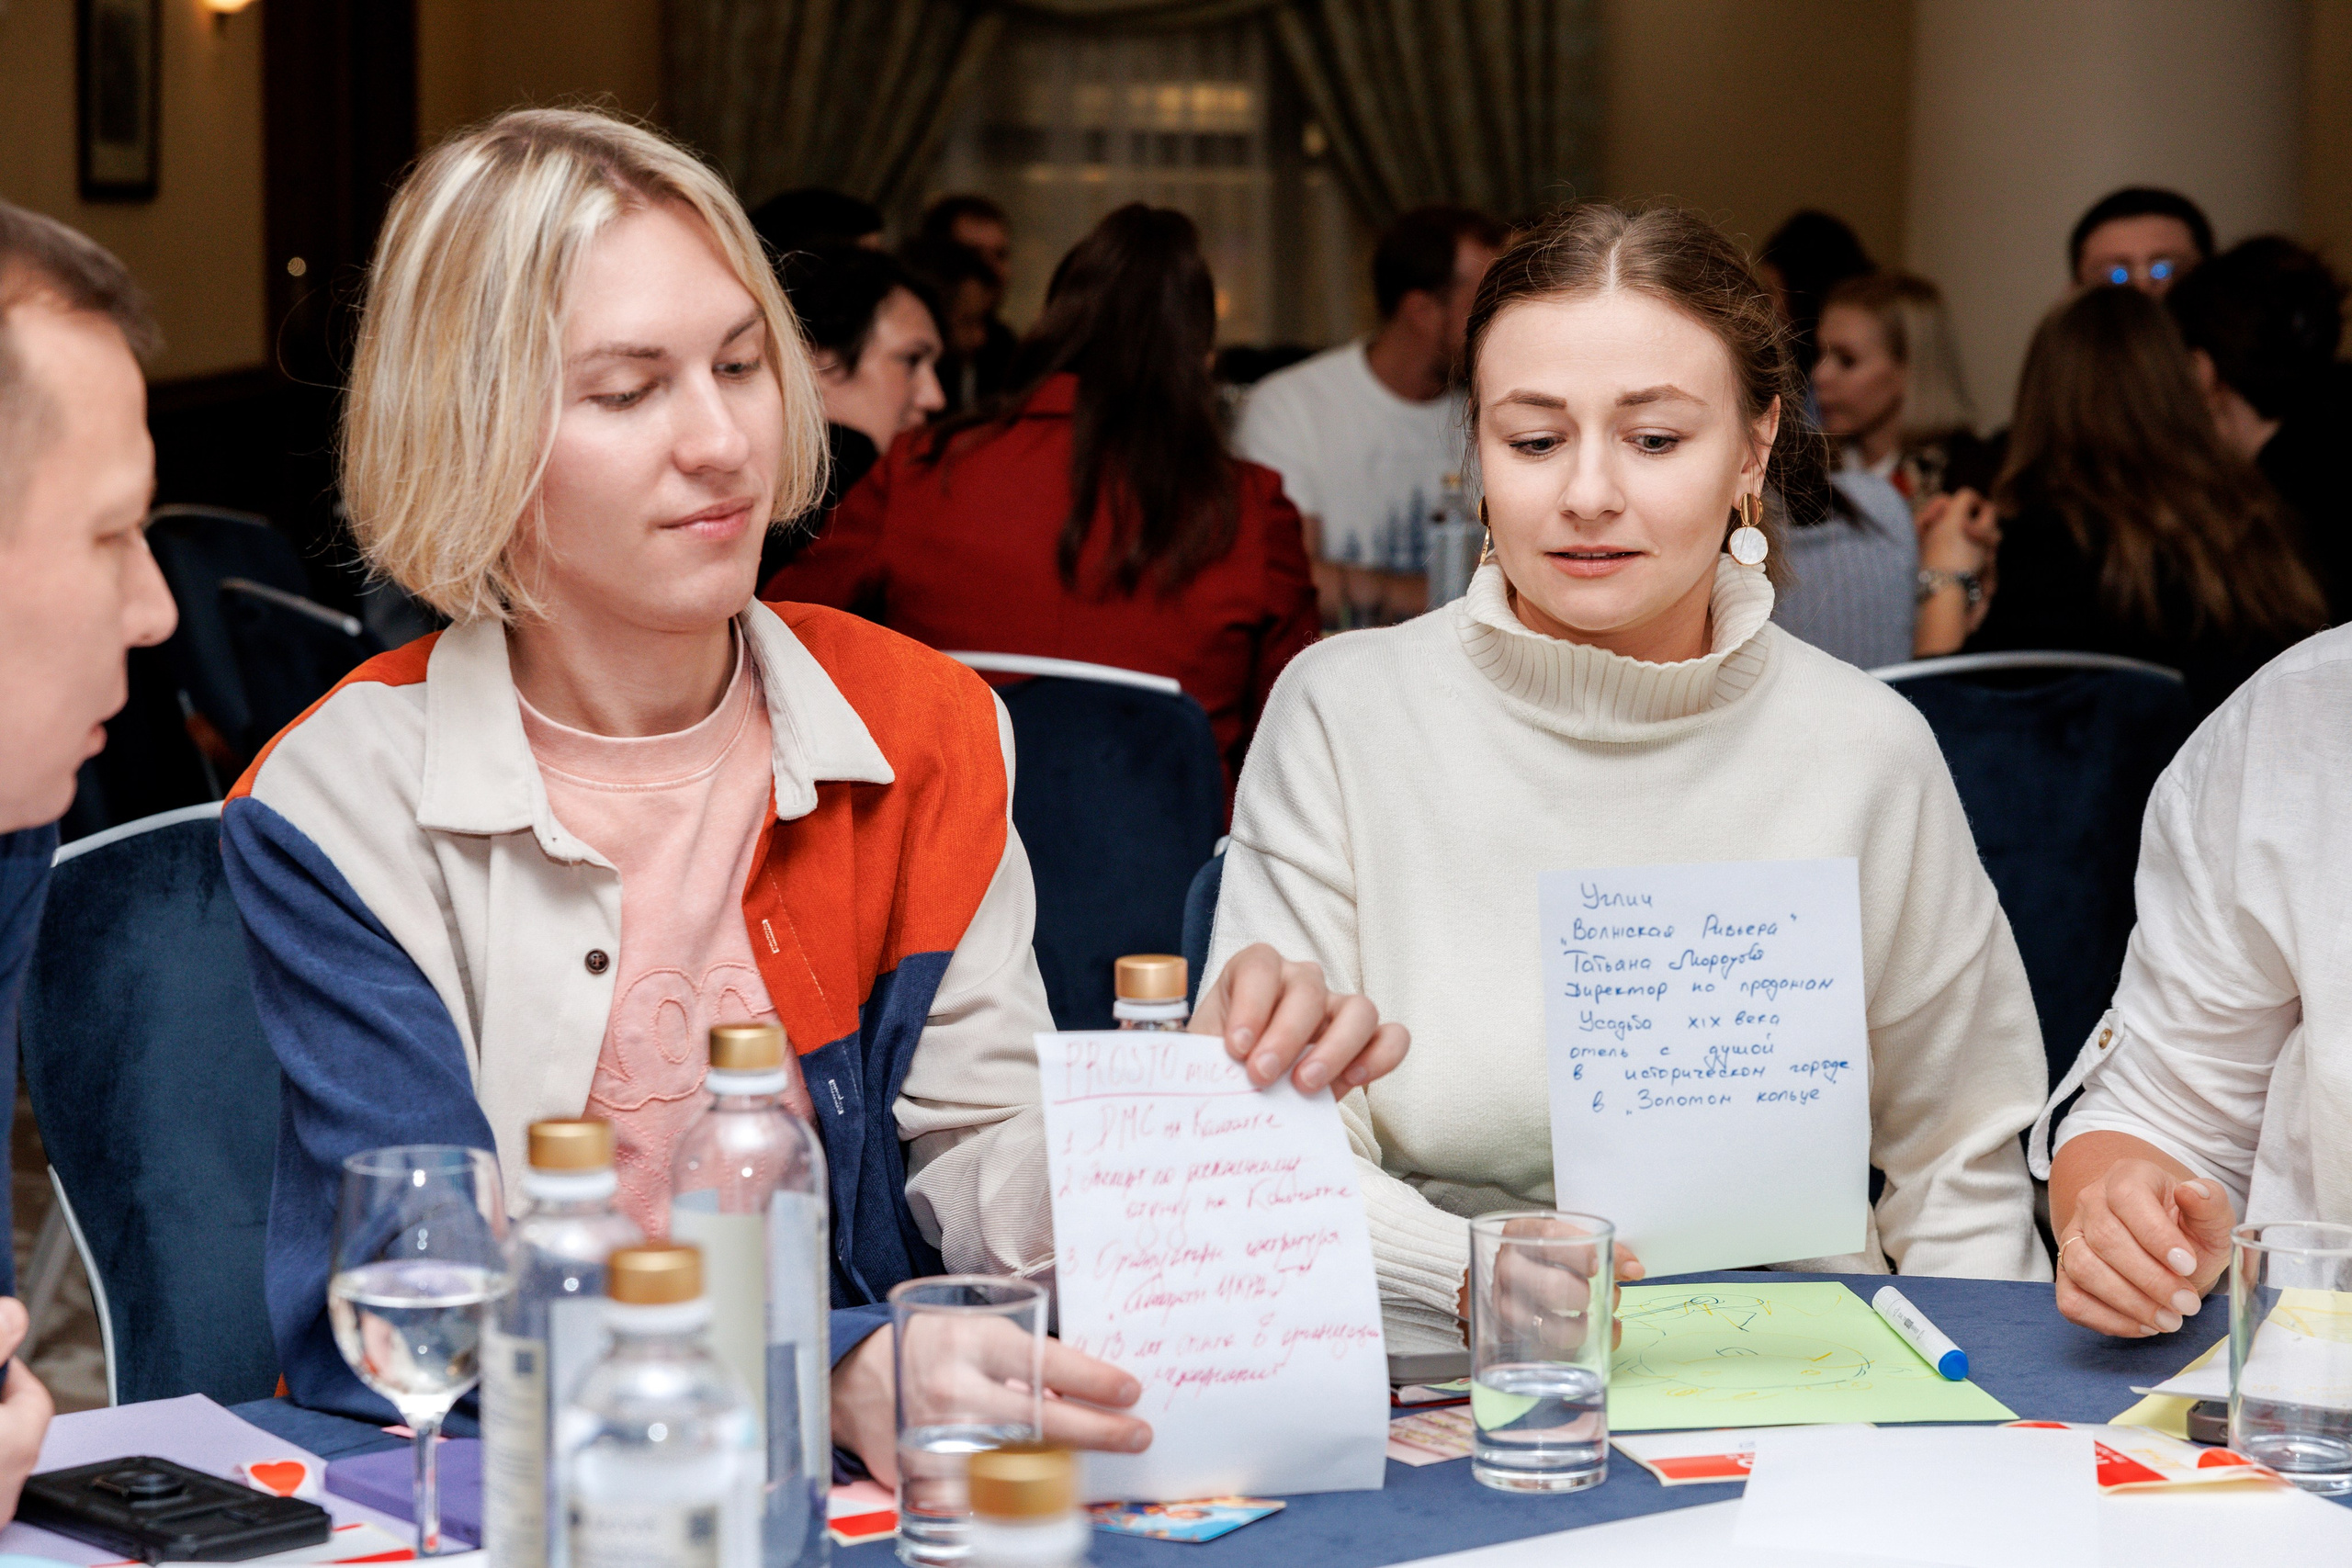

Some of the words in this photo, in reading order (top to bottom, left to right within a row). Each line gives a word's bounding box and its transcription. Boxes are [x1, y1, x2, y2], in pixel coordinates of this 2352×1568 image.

[1580, 882, 1654, 909] Углич
[1564, 981, 1668, 1004] Директор
[1692, 981, 1715, 993] по
[1578, 1010, 1652, 1041] Усадьба
[1735, 1010, 1781, 1026] века
[1569, 1045, 1629, 1058] отель
[1660, 1045, 1670, 1055] с
[1704, 1032, 1774, 1069] душой
[1573, 1064, 1583, 1080] в
[1624, 1064, 1766, 1086] историческом
